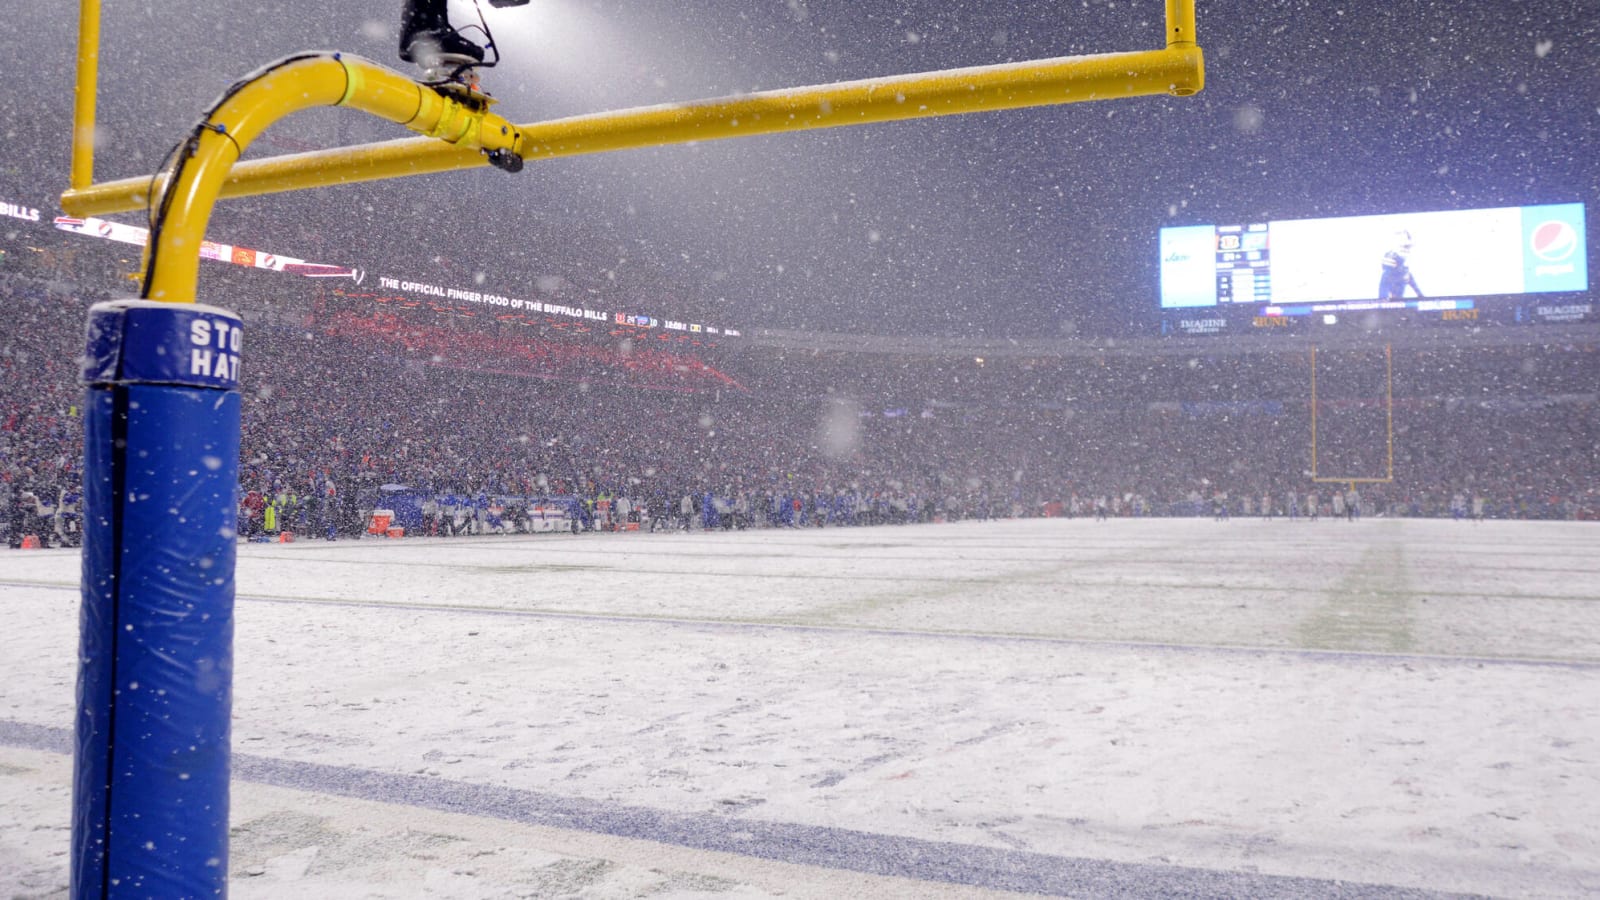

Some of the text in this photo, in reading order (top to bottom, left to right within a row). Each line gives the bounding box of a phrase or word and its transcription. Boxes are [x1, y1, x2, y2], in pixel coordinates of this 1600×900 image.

[0, 201, 40, 221] BILLS
[380, 277, 399, 289] THE
[401, 281, 445, 297] OFFICIAL
[447, 288, 481, 302] FINGER
[483, 294, 508, 306] FOOD
[511, 299, 523, 308] OF
[525, 301, 542, 311] THE
[543, 303, 582, 317] BUFFALO
[584, 310, 607, 321] BILLS
[1442, 308, 1480, 320] HUNT
[1536, 304, 1591, 316] IMAGINE
[1180, 319, 1227, 329] IMAGINE
[1254, 316, 1288, 328] HUNT
